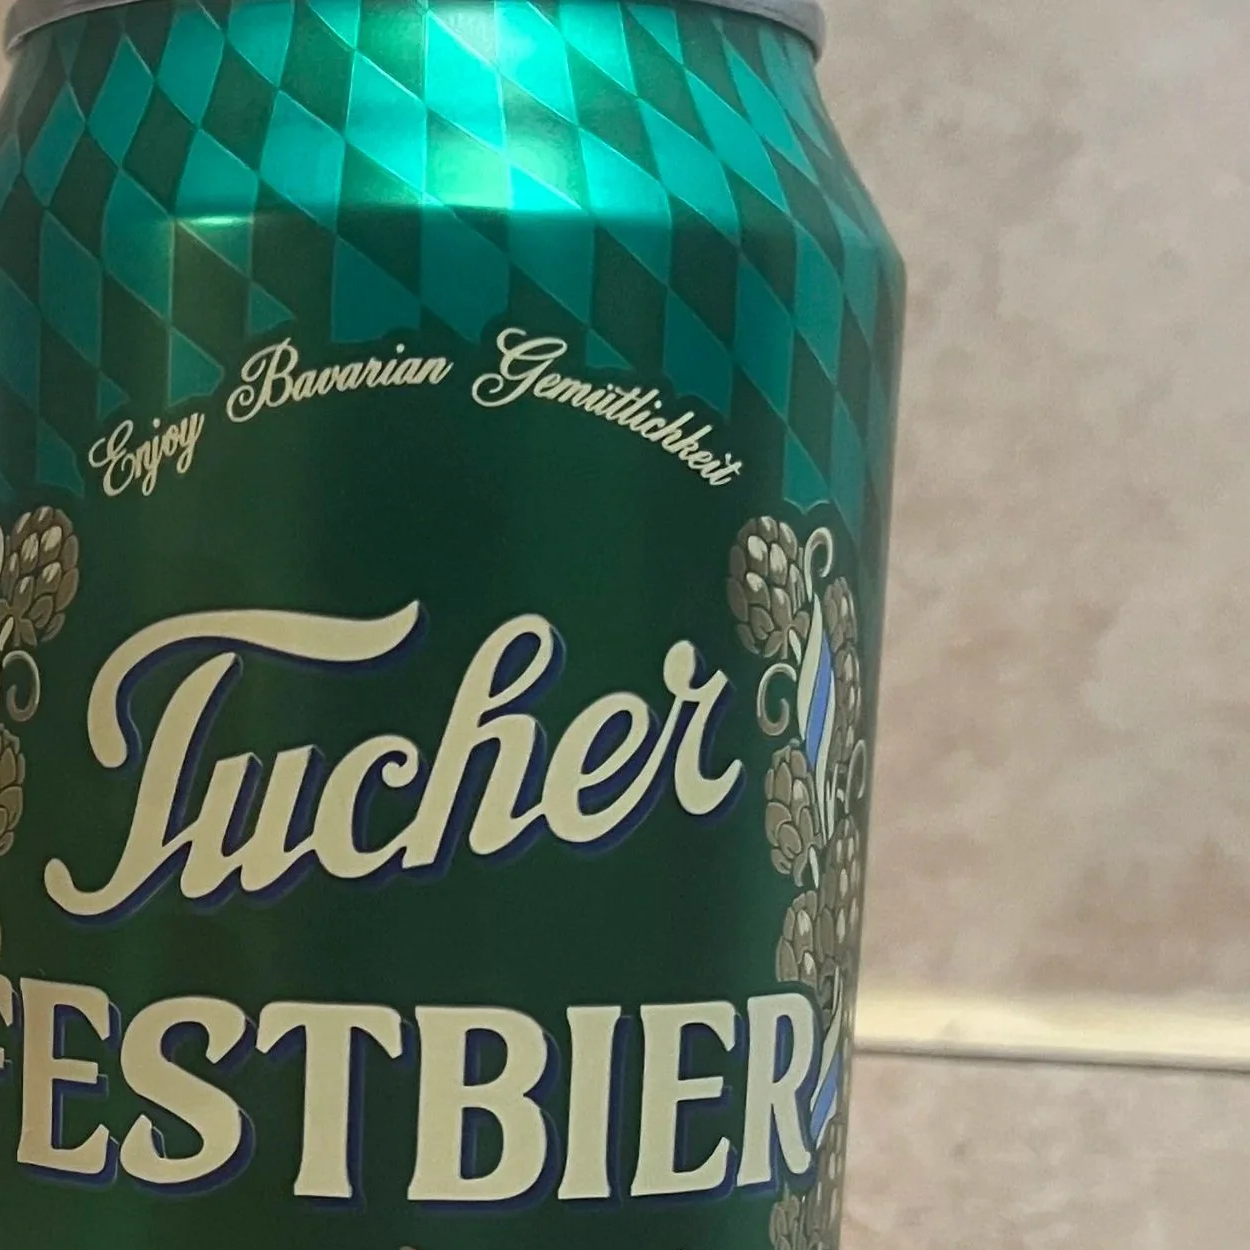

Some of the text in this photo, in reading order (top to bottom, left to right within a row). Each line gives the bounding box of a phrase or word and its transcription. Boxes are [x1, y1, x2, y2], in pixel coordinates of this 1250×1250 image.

[89, 328, 743, 497] Enjoy Bavarian Gemütlichkeit
[44, 600, 746, 918] Tucher
